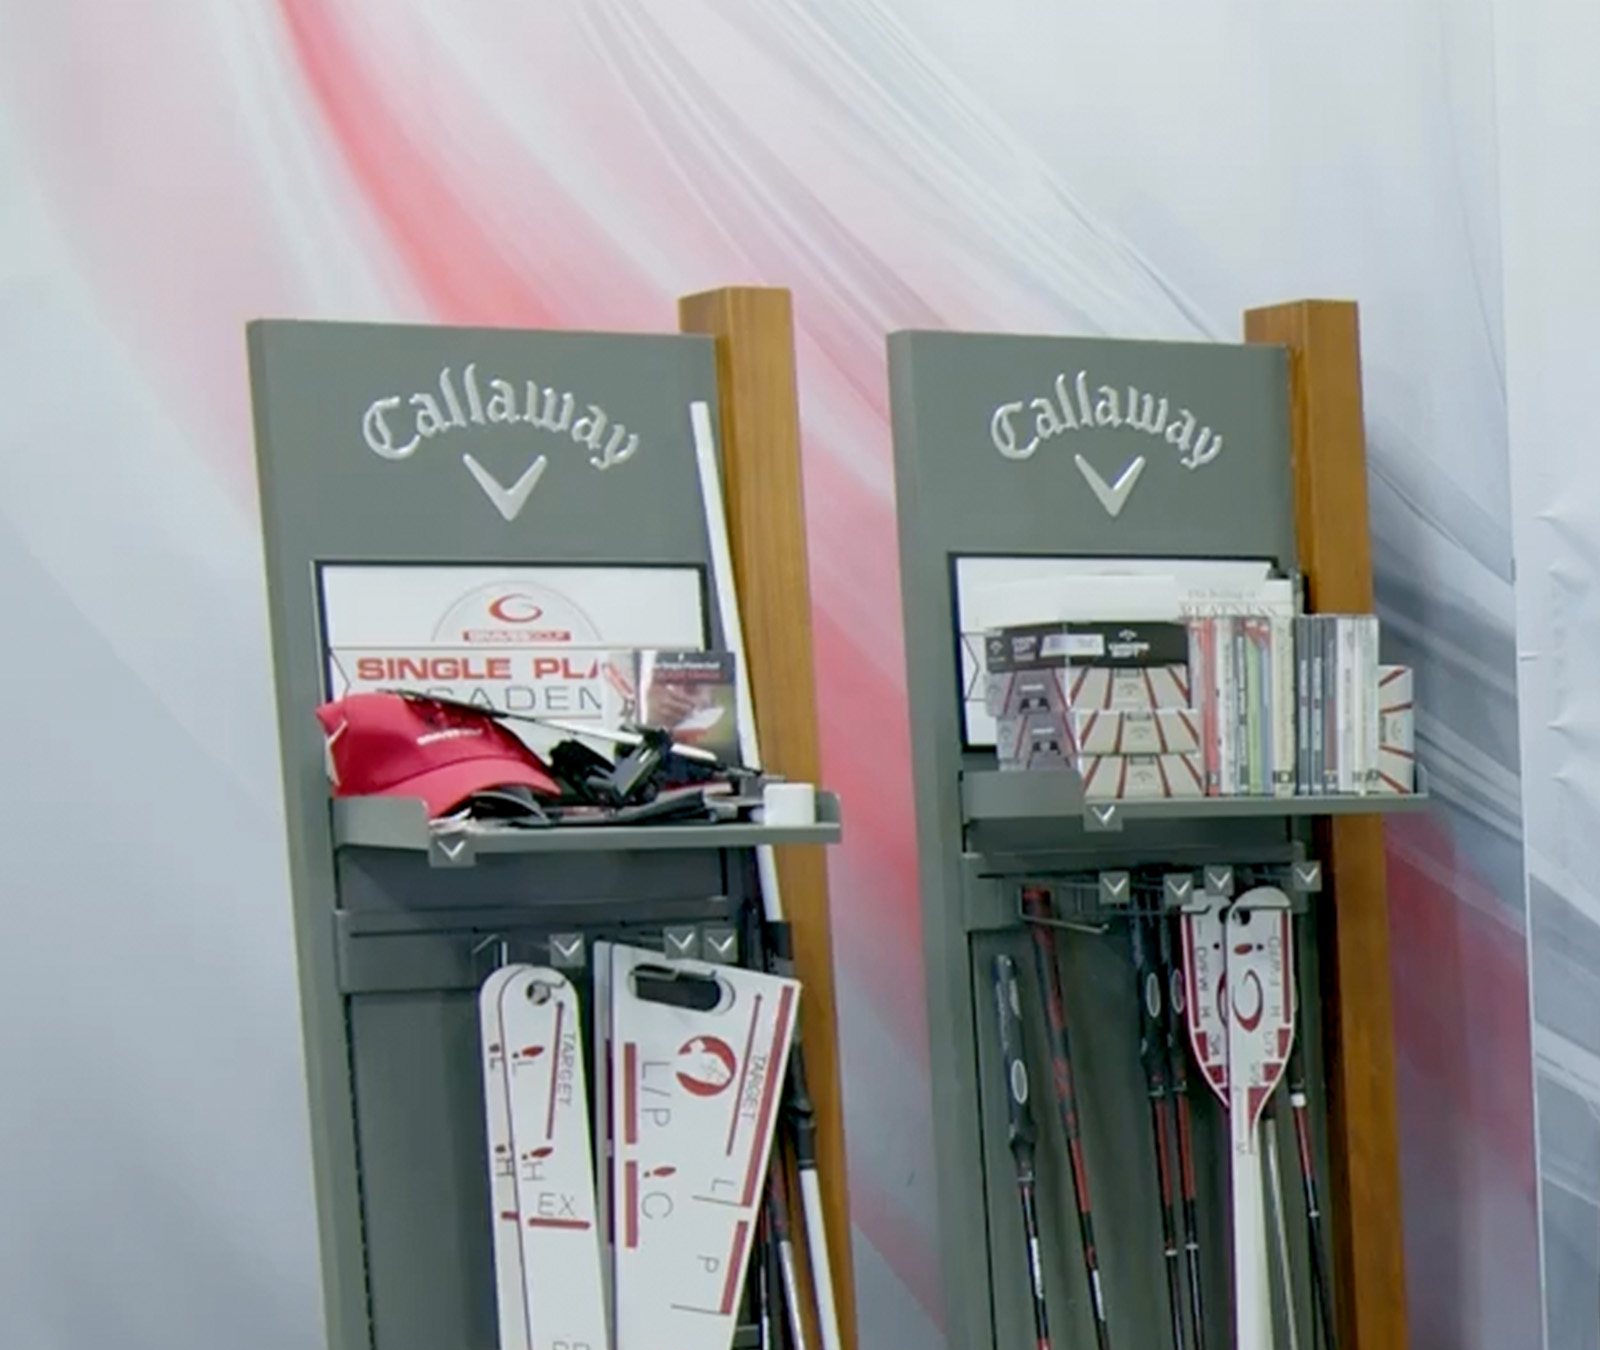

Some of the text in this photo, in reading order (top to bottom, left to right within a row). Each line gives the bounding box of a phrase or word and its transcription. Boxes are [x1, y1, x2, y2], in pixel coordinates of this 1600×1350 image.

[362, 363, 639, 470] Callaway
[991, 370, 1223, 469] Callaway
[357, 657, 512, 681] SINGLE
[558, 1033, 576, 1107] TARGET
[742, 1055, 767, 1122] TARGET
[537, 1191, 576, 1218] EX
